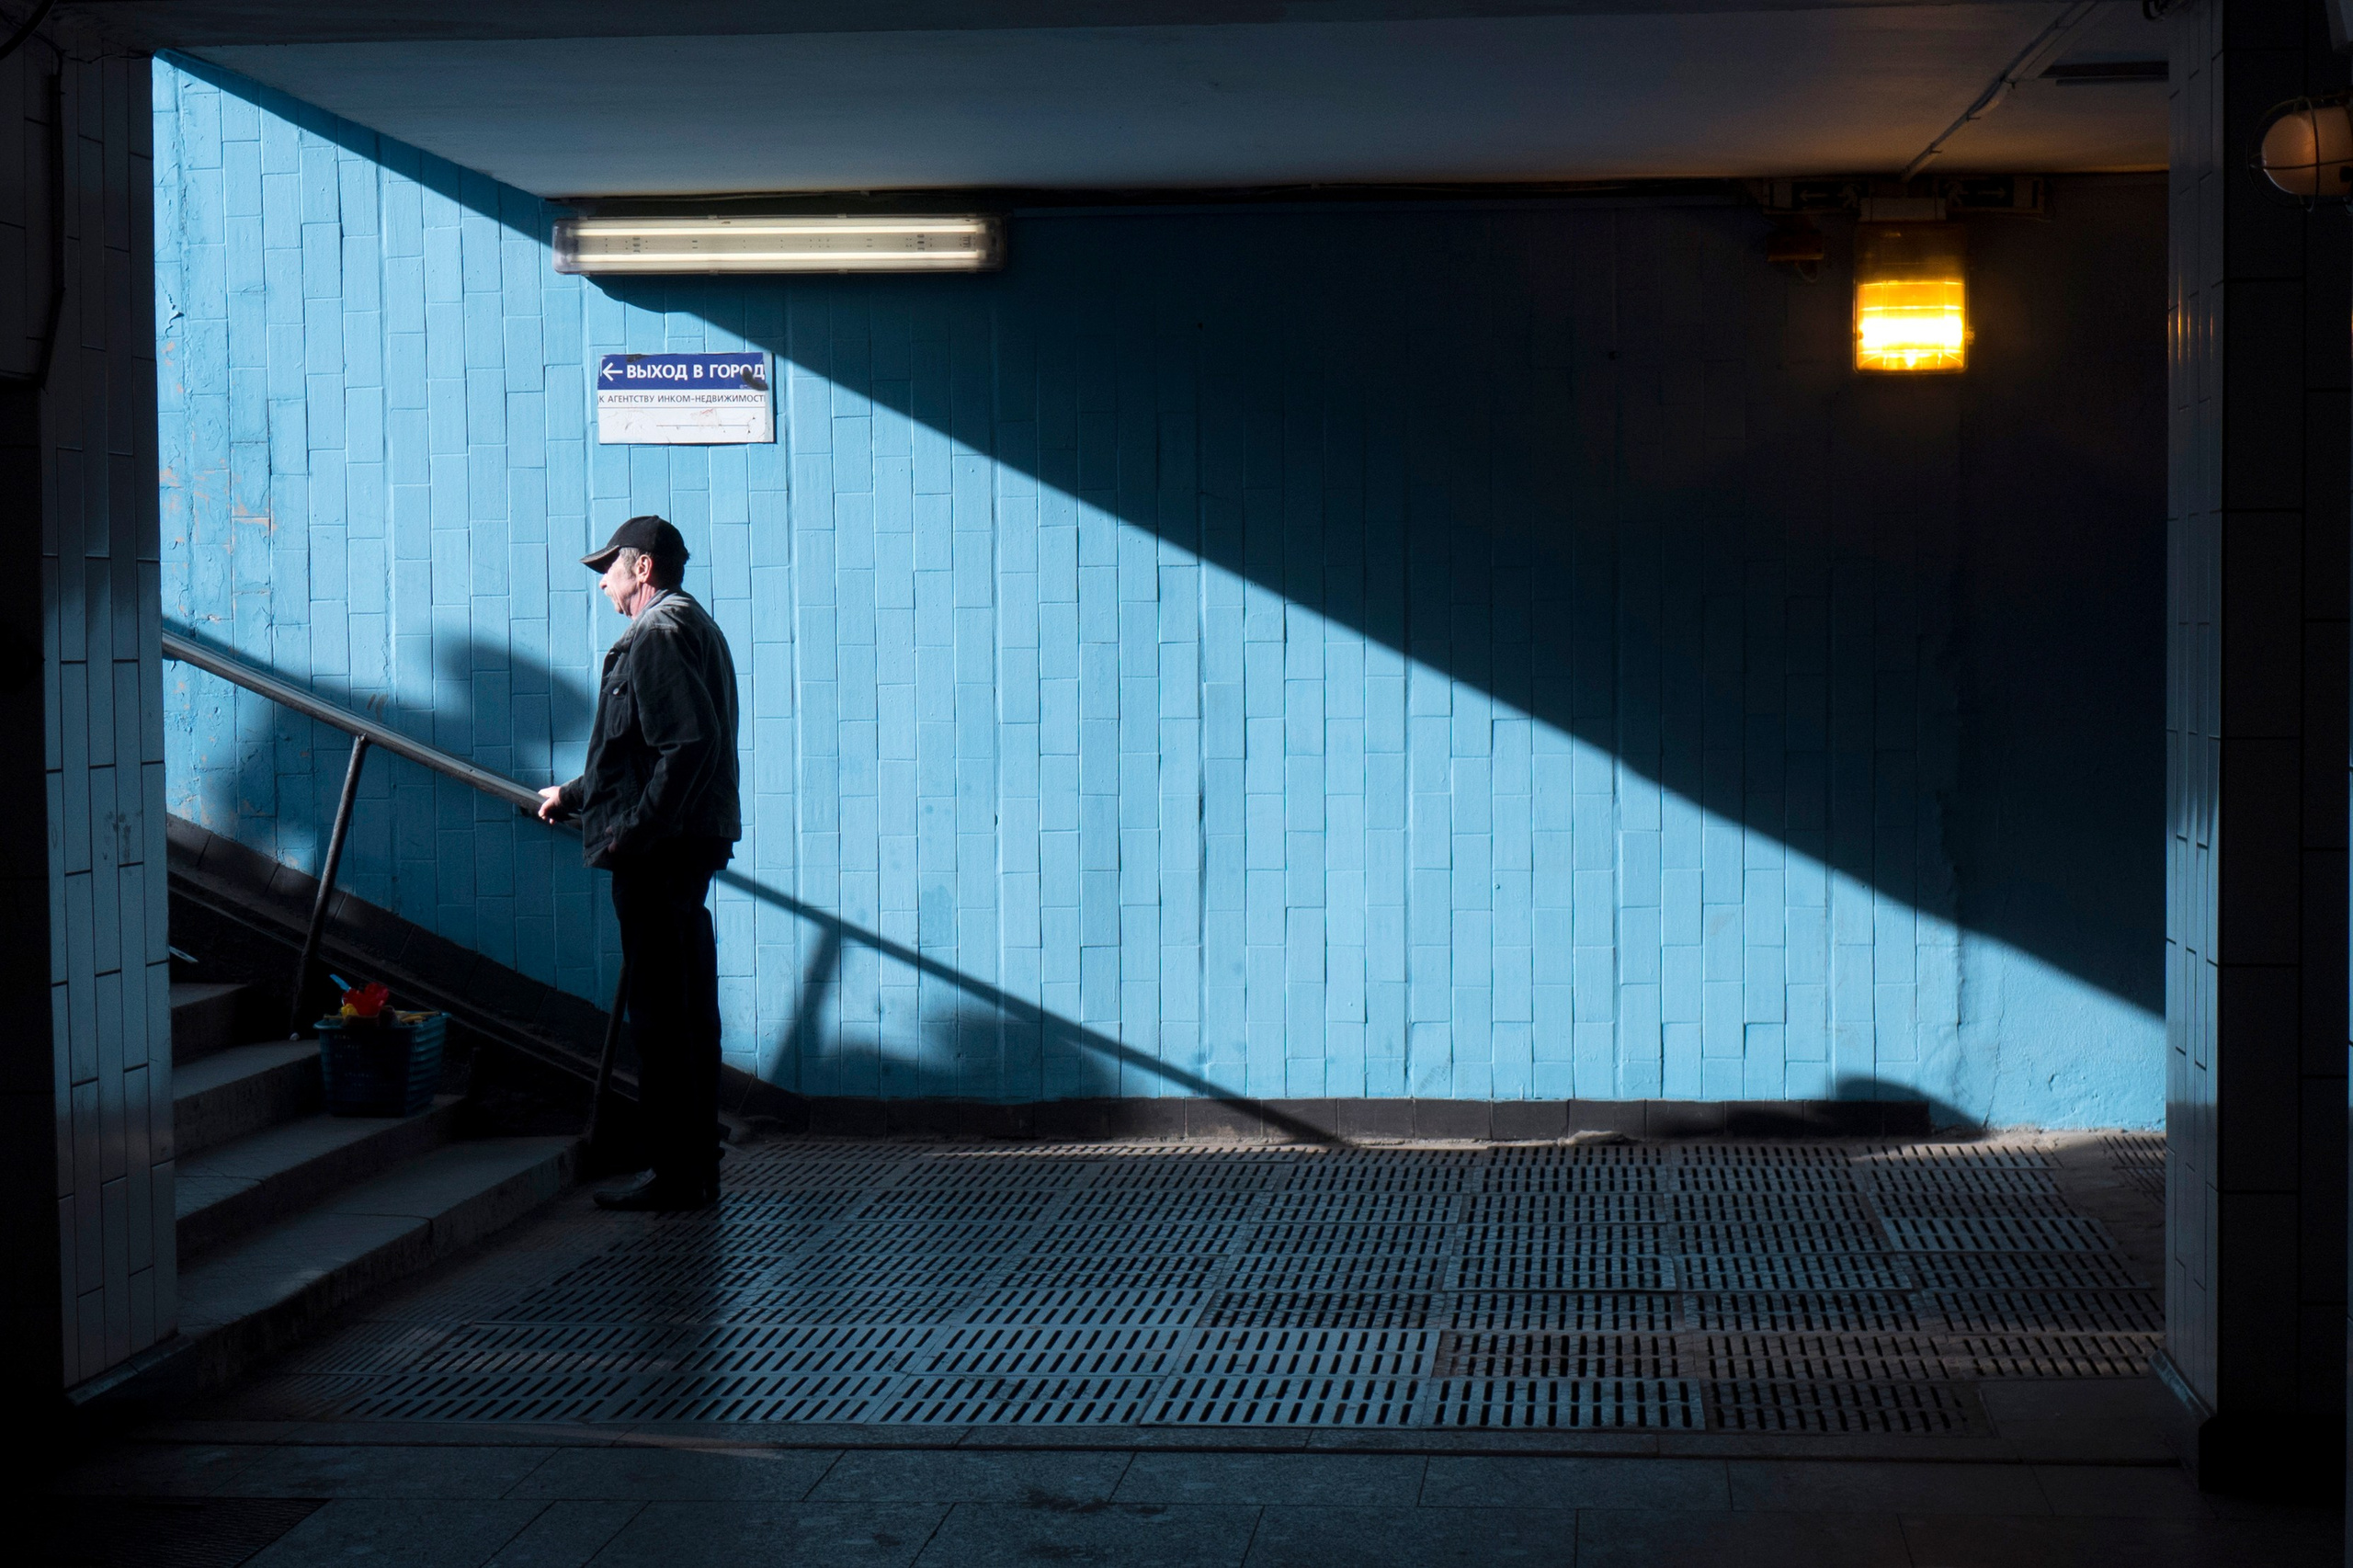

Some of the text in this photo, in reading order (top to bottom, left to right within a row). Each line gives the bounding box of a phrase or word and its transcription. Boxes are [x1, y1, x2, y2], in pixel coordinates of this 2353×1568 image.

[626, 364, 688, 381] ВЫХОД
[693, 364, 703, 379] В
[657, 394, 766, 403] ИНКОМ-НЕДВИЖИМОСТ
